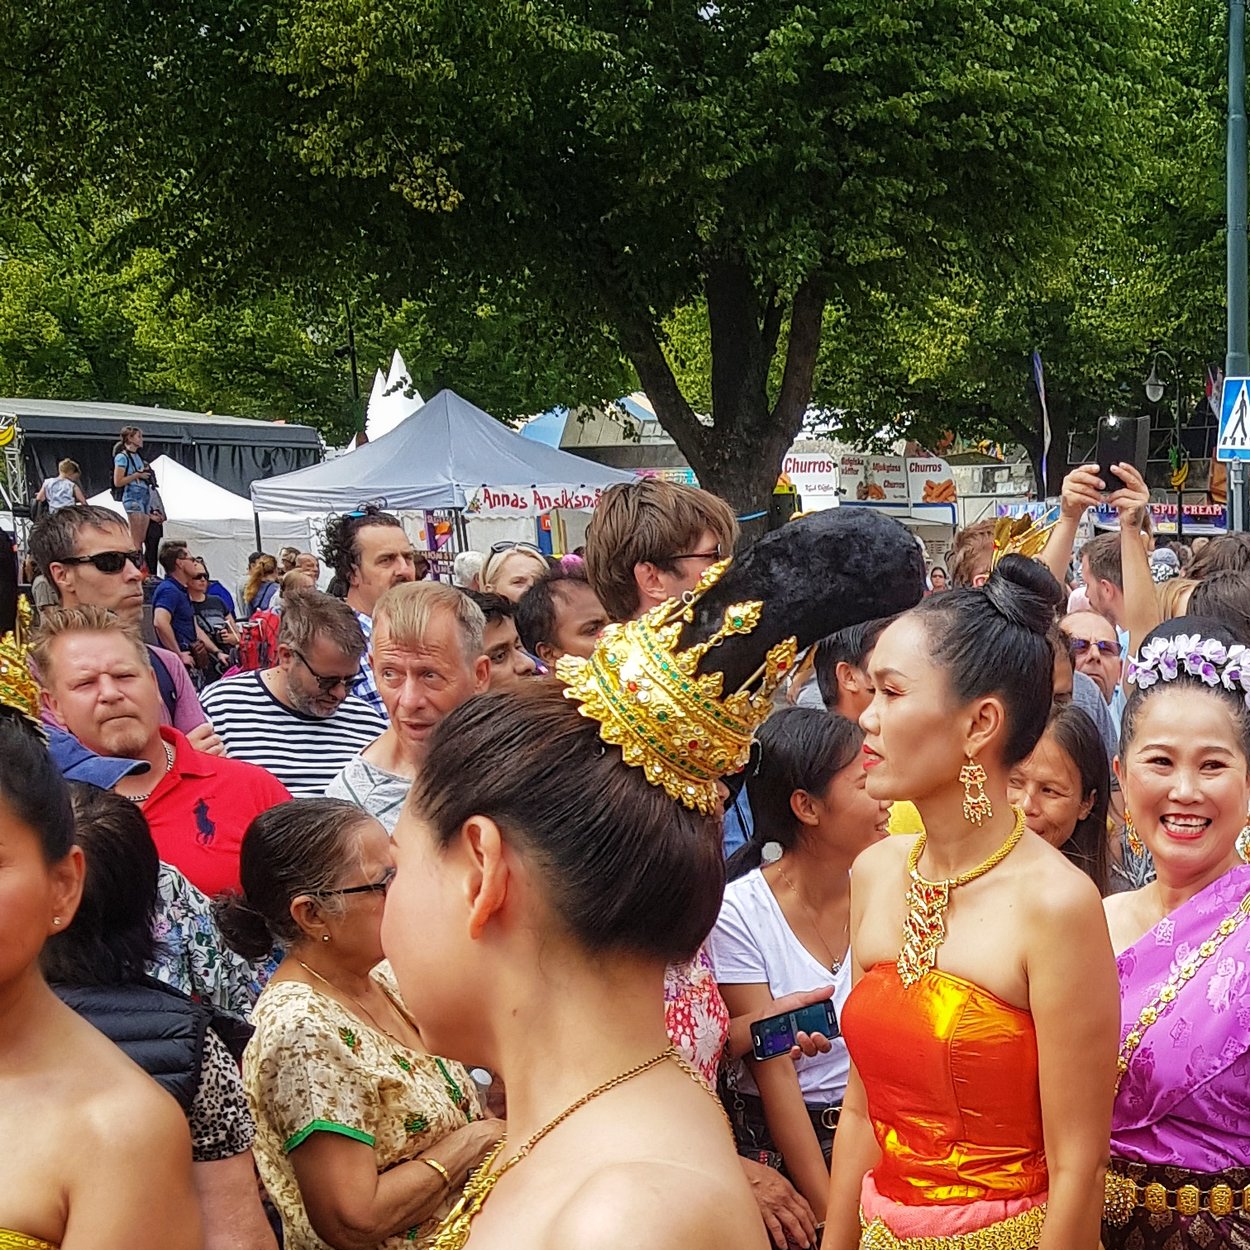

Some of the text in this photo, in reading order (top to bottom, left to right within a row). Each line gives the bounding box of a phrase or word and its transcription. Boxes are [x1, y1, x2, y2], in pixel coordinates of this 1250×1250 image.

[784, 457, 833, 474] Churros
[909, 462, 942, 473] Churros
[883, 479, 905, 489] Churros
[483, 488, 528, 509] Annas
[1183, 504, 1222, 516] CREAM
